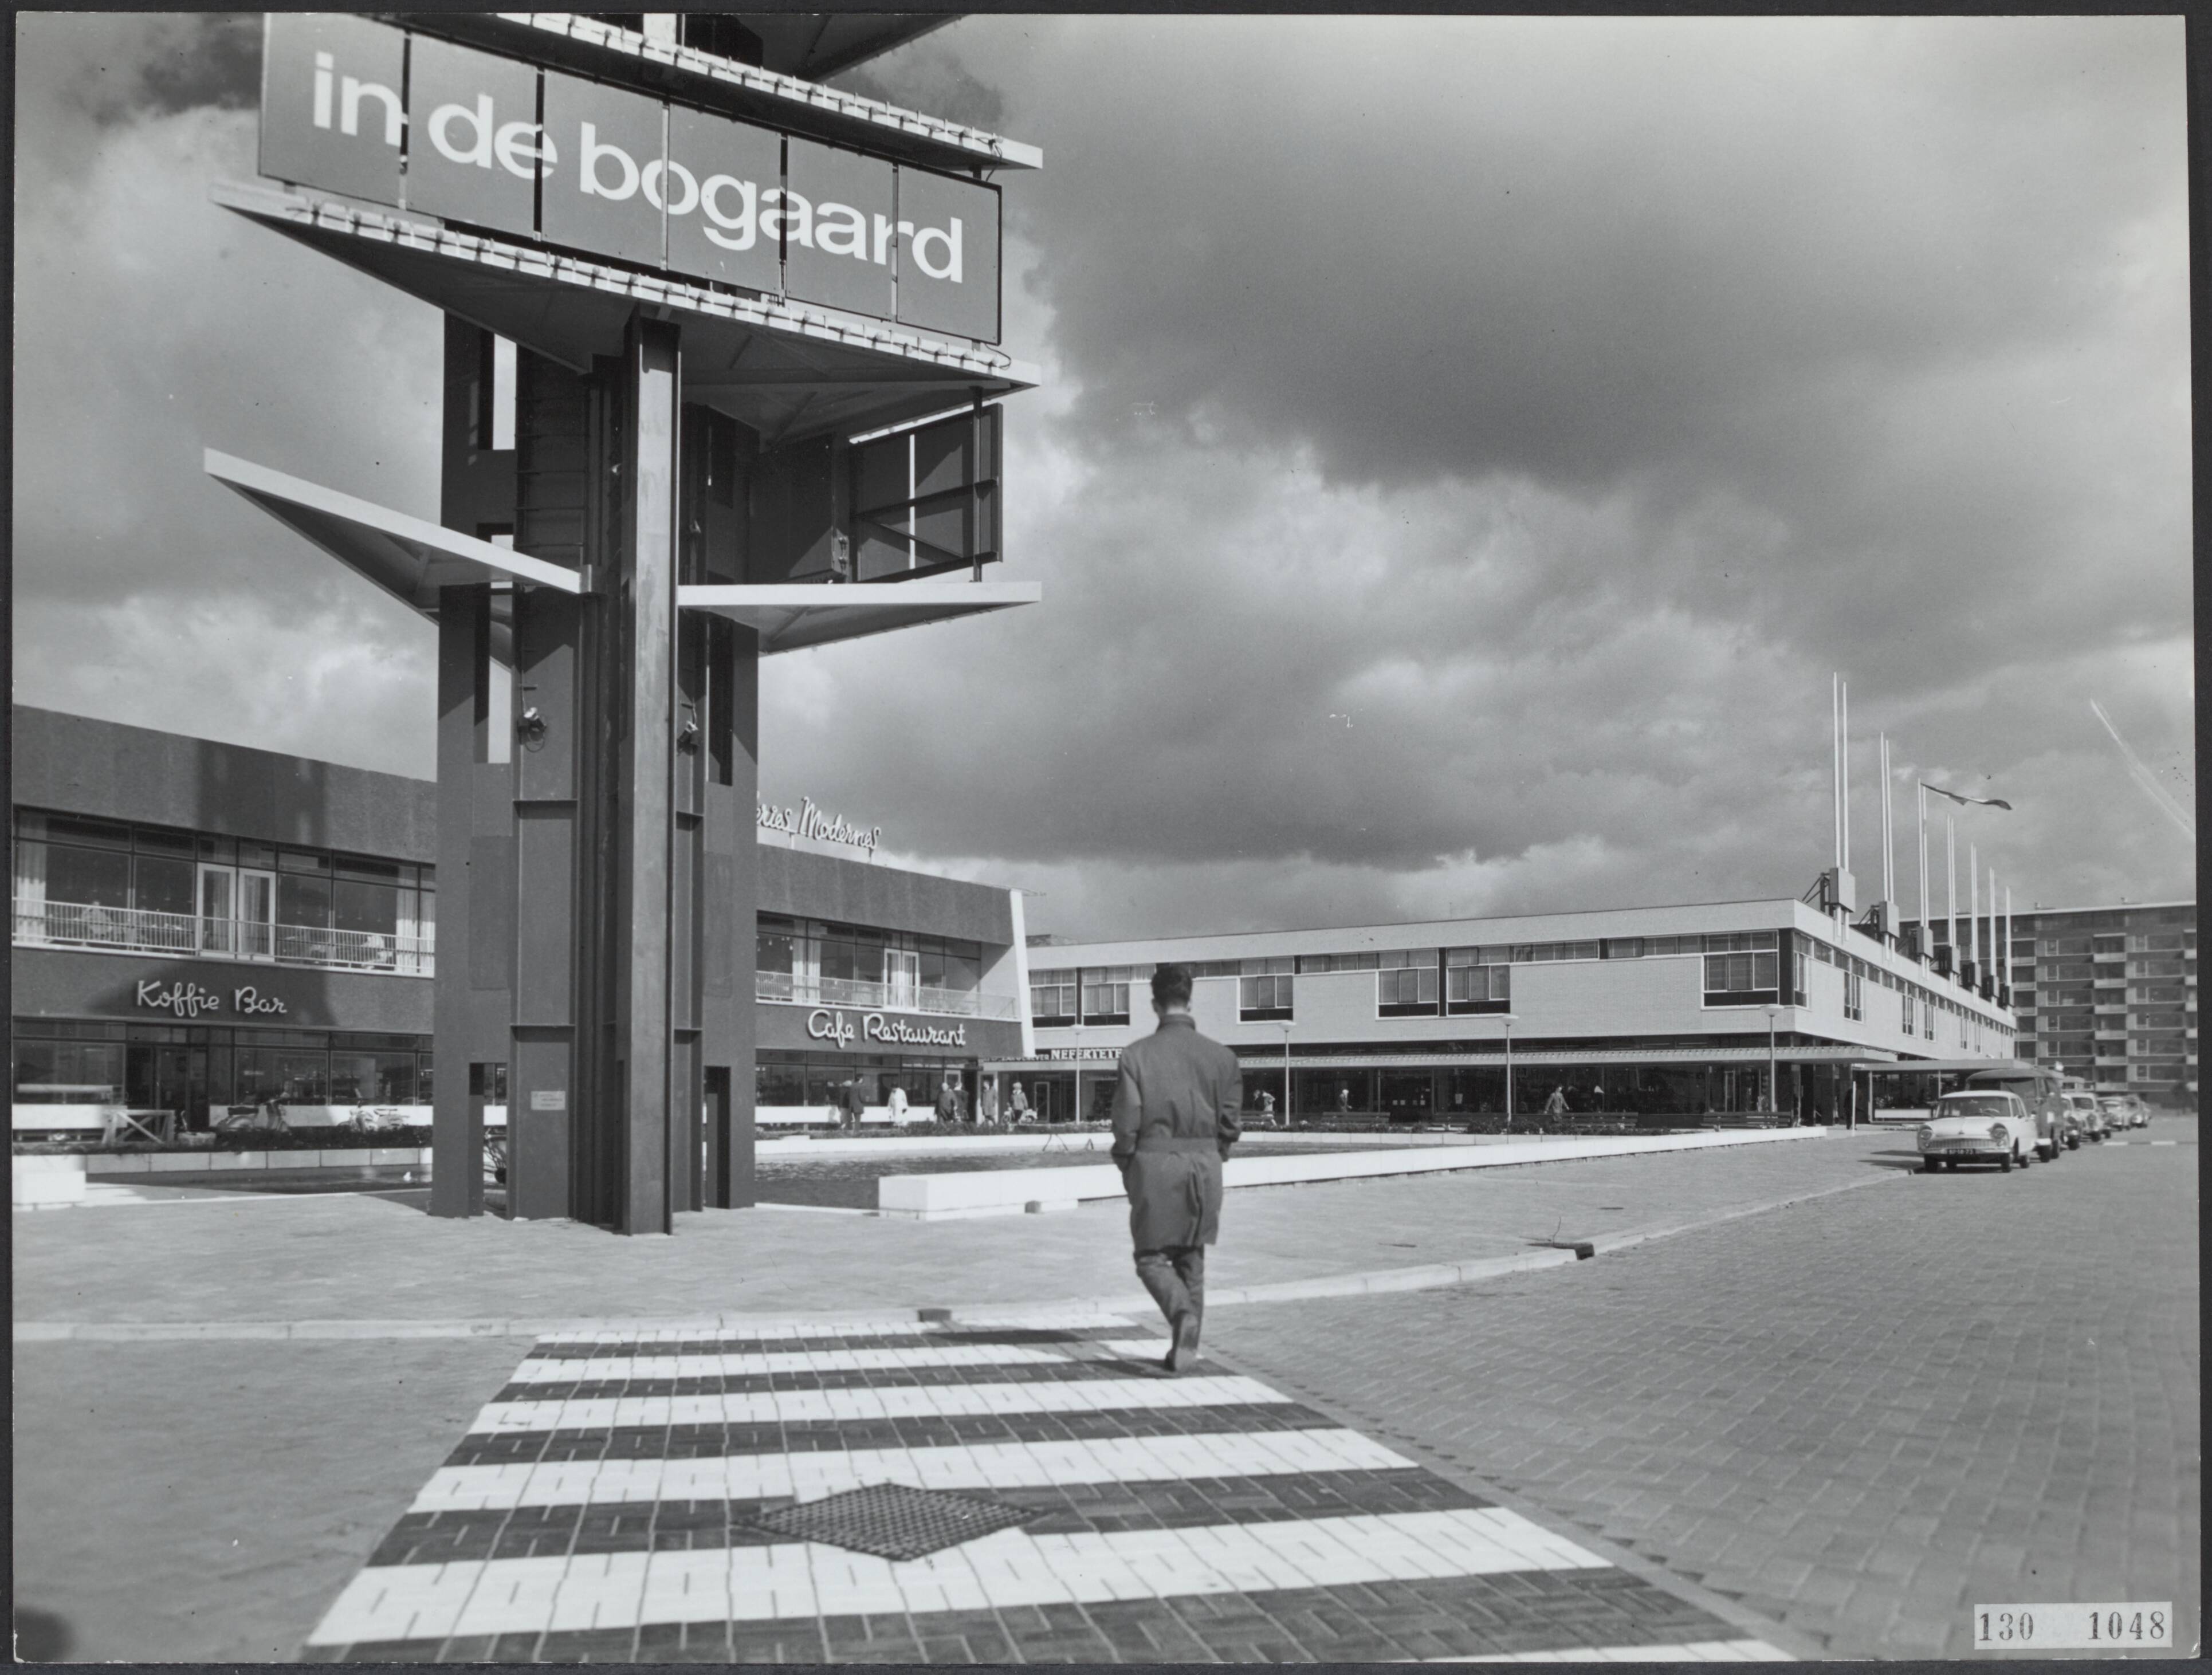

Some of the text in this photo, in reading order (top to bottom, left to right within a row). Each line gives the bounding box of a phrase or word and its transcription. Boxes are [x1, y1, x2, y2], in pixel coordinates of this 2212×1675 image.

[313, 51, 962, 283] in de bogaard
[800, 796, 881, 849] Modernes
[137, 980, 287, 1017] Koffie Bar
[808, 1009, 966, 1048] Cafe Restaurant
